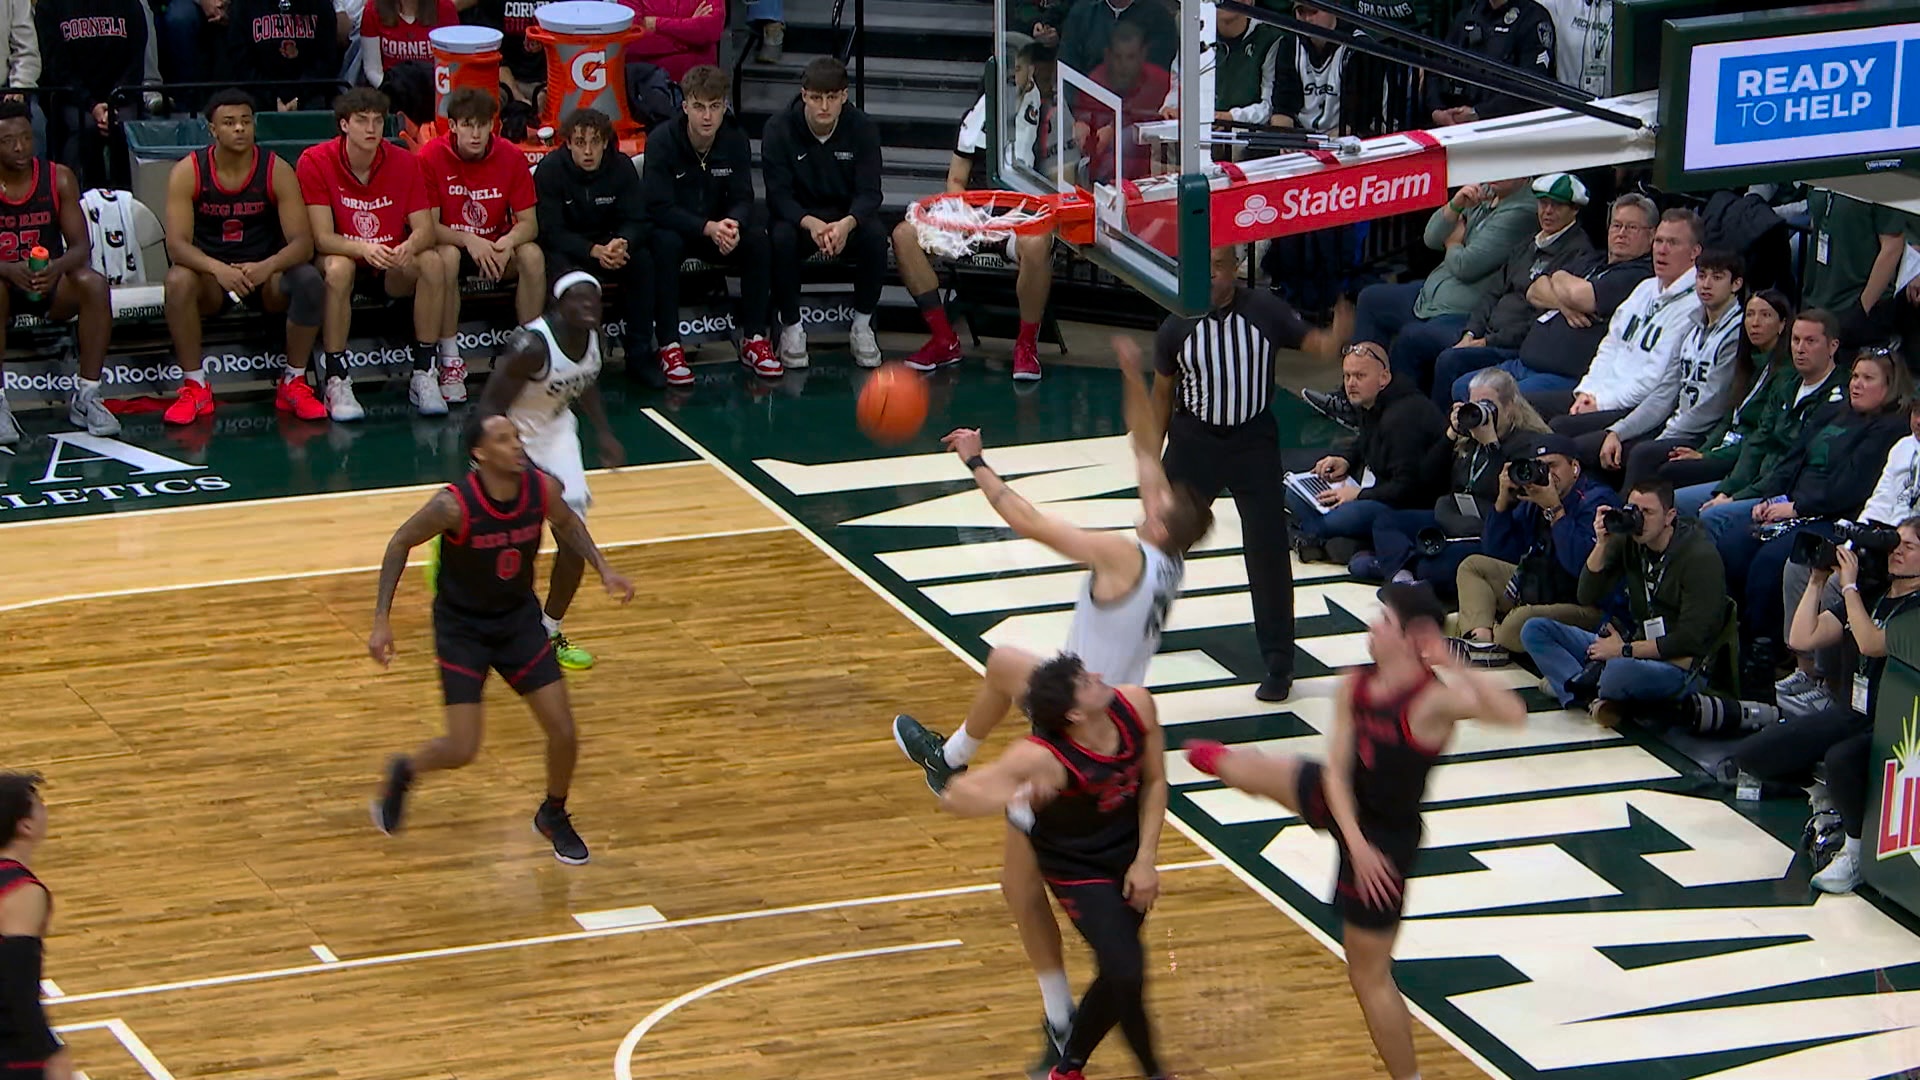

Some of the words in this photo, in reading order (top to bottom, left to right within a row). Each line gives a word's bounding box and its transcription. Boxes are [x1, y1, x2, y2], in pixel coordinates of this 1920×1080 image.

[504, 0, 551, 18] CORN
[1357, 1, 1412, 18] SPARTANS
[252, 14, 318, 42] CORNEL
[381, 36, 433, 57] CORNEL
[435, 65, 451, 95] G
[571, 51, 607, 91] G
[1736, 57, 1878, 99] READY
[1736, 101, 1778, 128] TO
[1784, 91, 1872, 123] HELP
[223, 218, 244, 243] 2
[0, 229, 41, 262] 23
[119, 304, 165, 319] SPARTAN
[678, 312, 735, 335] ocket
[799, 304, 856, 324] Rocke
[455, 328, 513, 350] Rocke
[115, 363, 184, 385] Rocke
[223, 351, 288, 374] Rocke
[4, 371, 81, 392] Rocket
[0, 431, 208, 485] A
[0, 476, 232, 510] LETICS
[496, 547, 521, 581] 0
